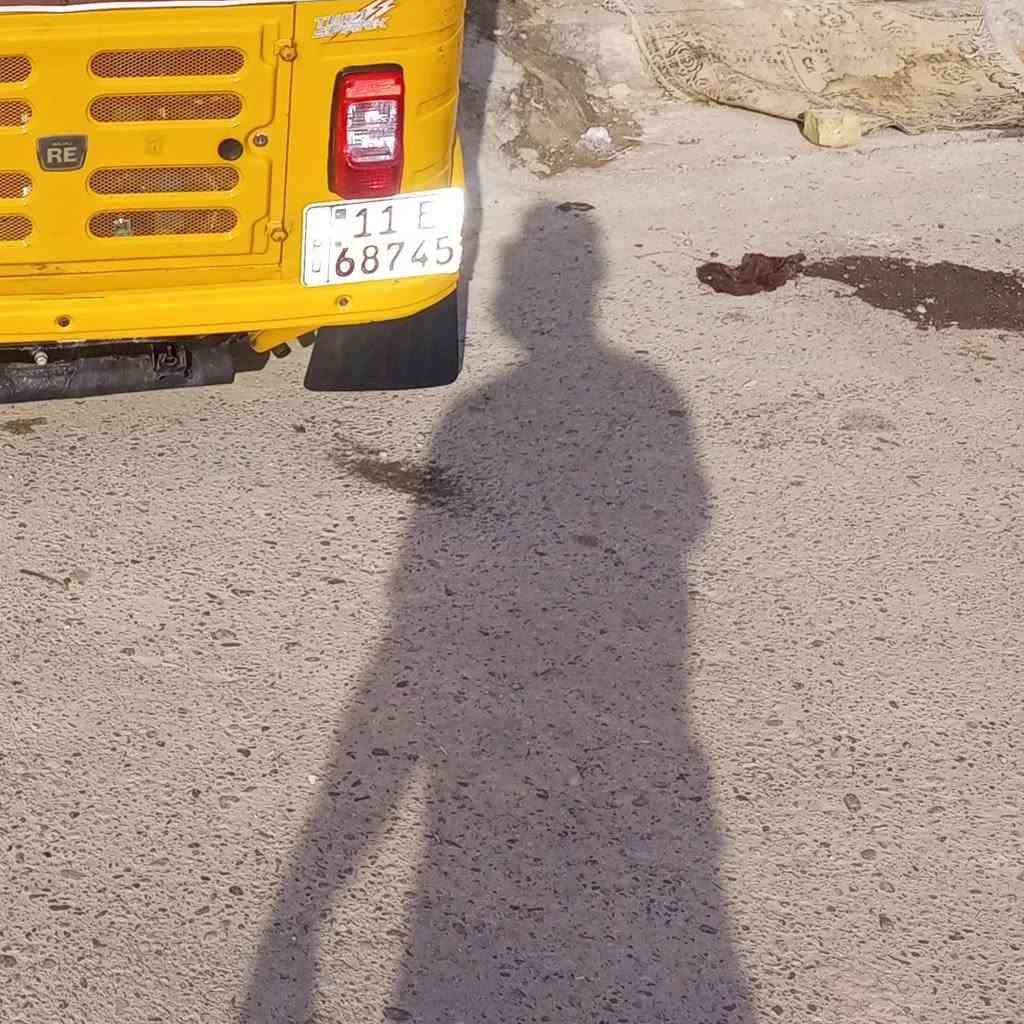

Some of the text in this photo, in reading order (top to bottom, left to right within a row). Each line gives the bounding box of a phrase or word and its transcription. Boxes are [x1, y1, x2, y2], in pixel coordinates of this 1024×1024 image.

[47, 146, 78, 164] RE
[353, 204, 398, 239] 11
[334, 234, 455, 278] 68745
